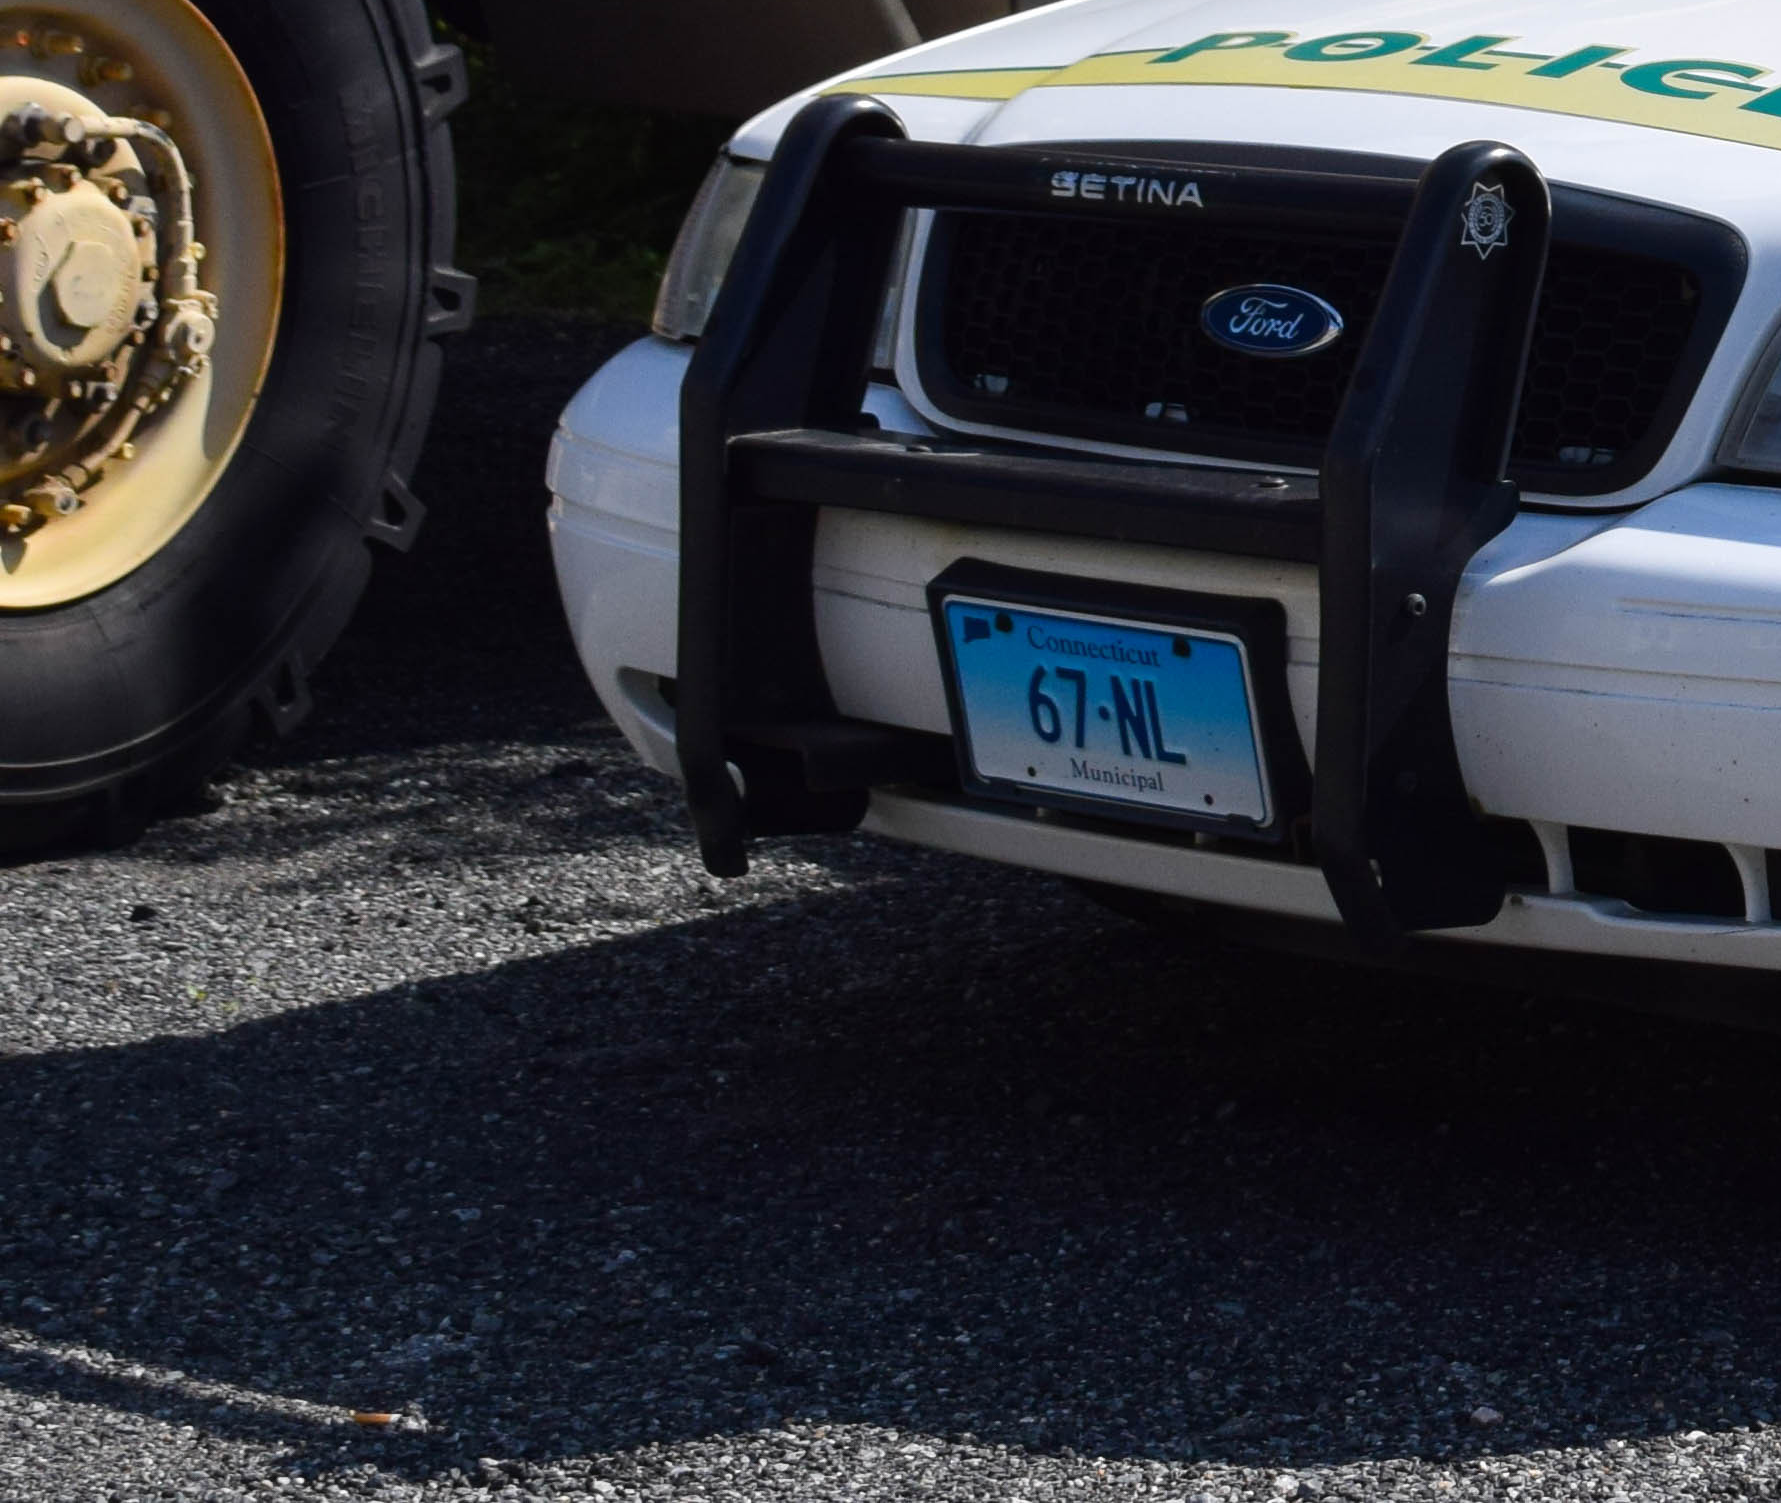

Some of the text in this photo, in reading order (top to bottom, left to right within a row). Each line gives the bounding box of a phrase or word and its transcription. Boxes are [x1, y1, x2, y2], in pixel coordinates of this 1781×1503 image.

[1051, 170, 1204, 208] SETINA
[1229, 296, 1304, 339] Ford
[1026, 624, 1162, 668] Connecticut
[1070, 756, 1165, 792] Municipal
